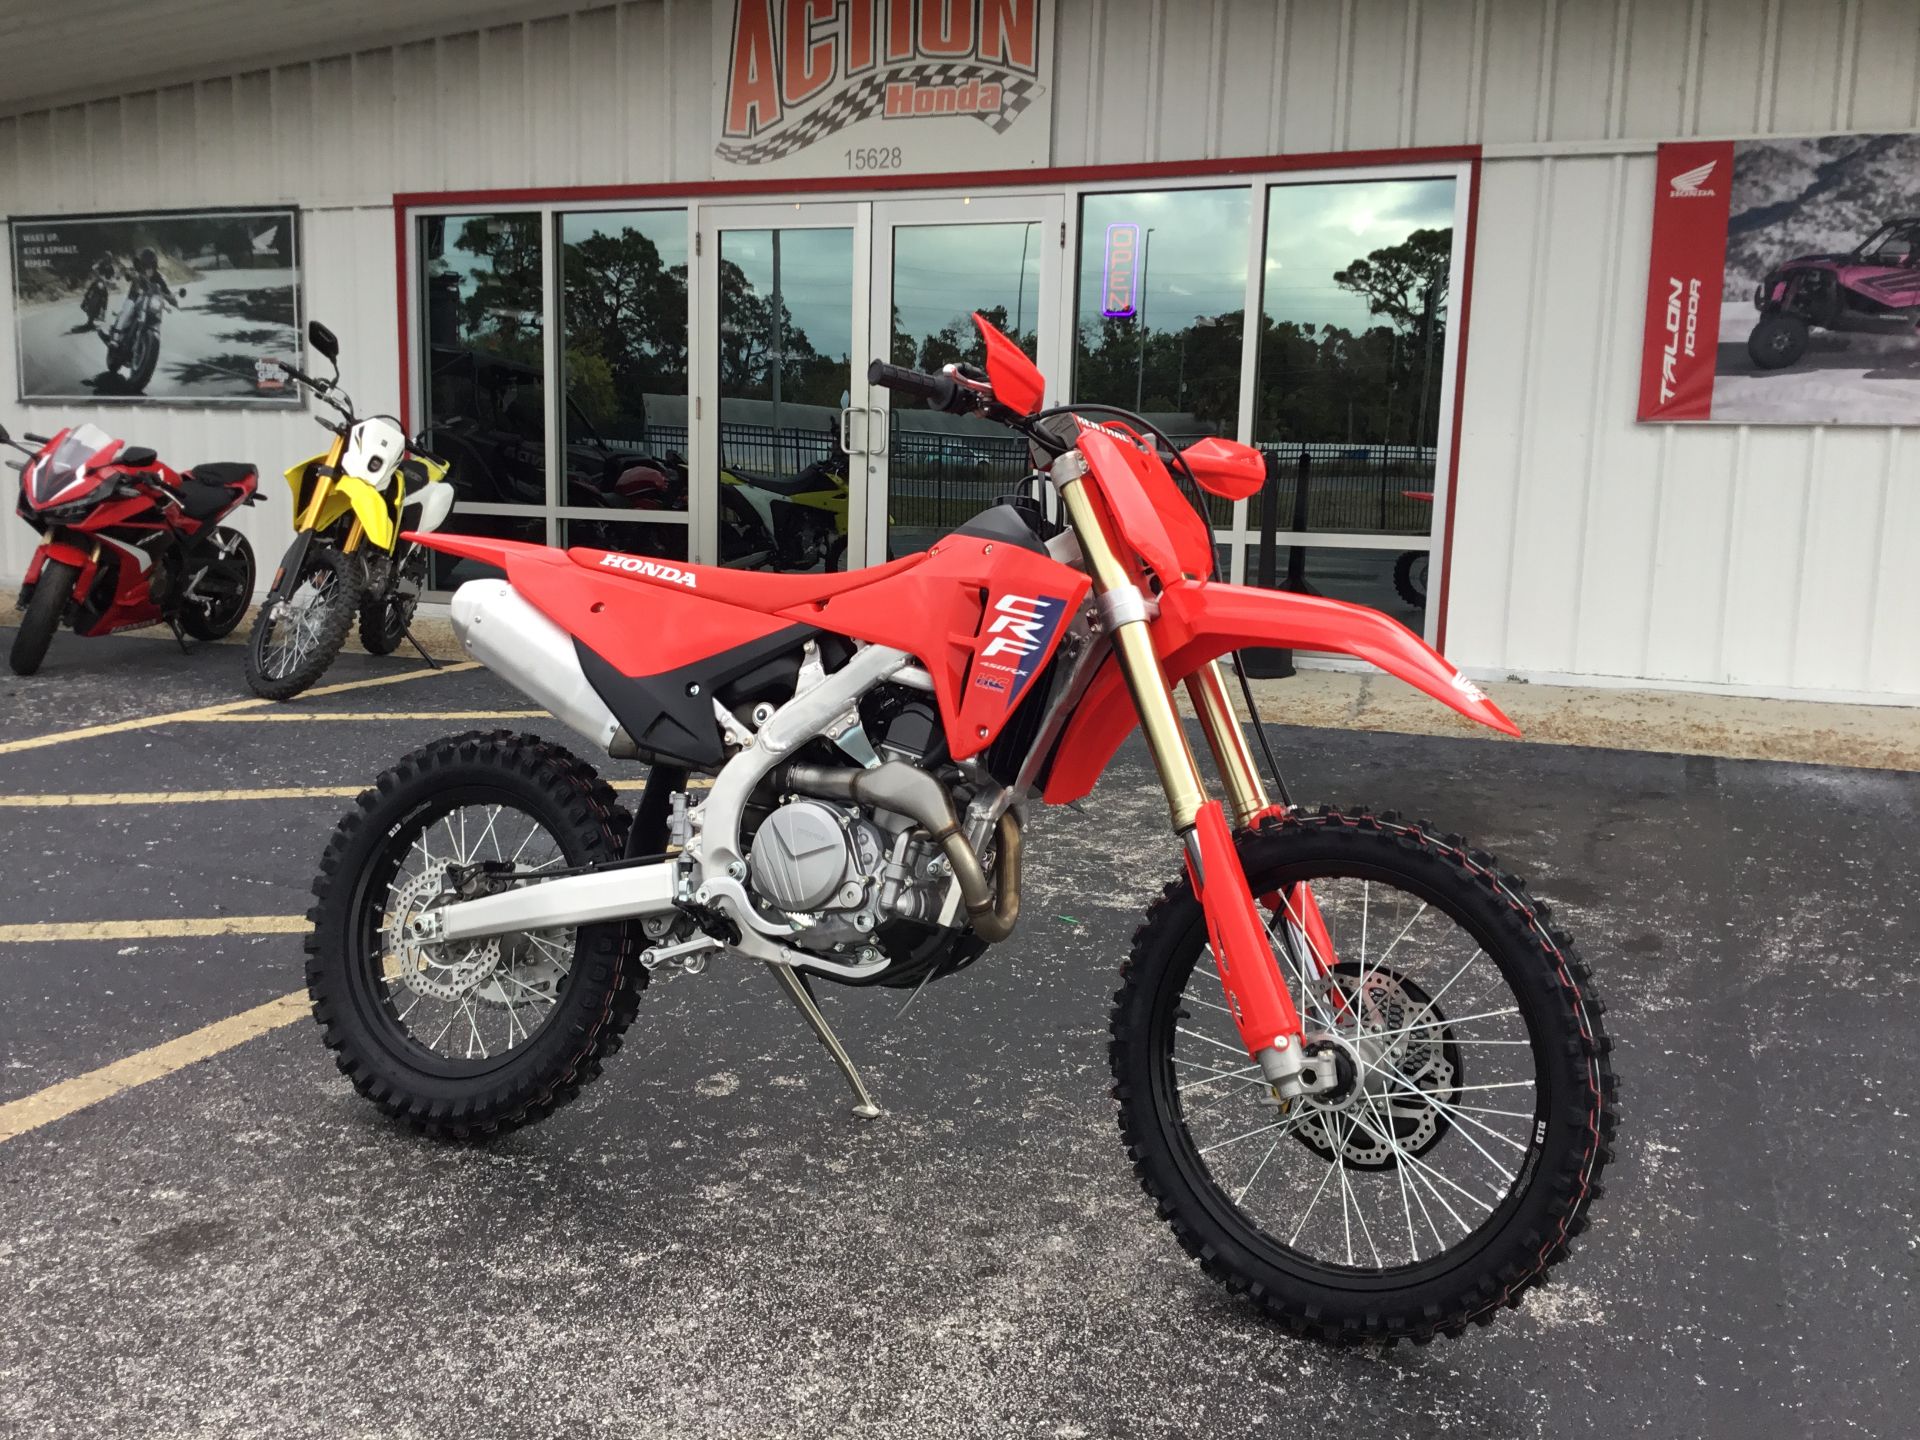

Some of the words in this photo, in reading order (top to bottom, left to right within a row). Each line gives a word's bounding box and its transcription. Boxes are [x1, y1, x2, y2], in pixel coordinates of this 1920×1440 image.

[722, 0, 1037, 138] ACTION
[883, 77, 1003, 119] Honda
[845, 147, 902, 170] 15628
[1670, 189, 1716, 198] HONDA
[1109, 229, 1133, 311] OPEN
[1660, 277, 1684, 405] TALON
[1684, 278, 1702, 357] 1000R
[600, 553, 697, 588] HONDA
[981, 594, 1052, 657] CRF
[979, 661, 1029, 678] 450RX
